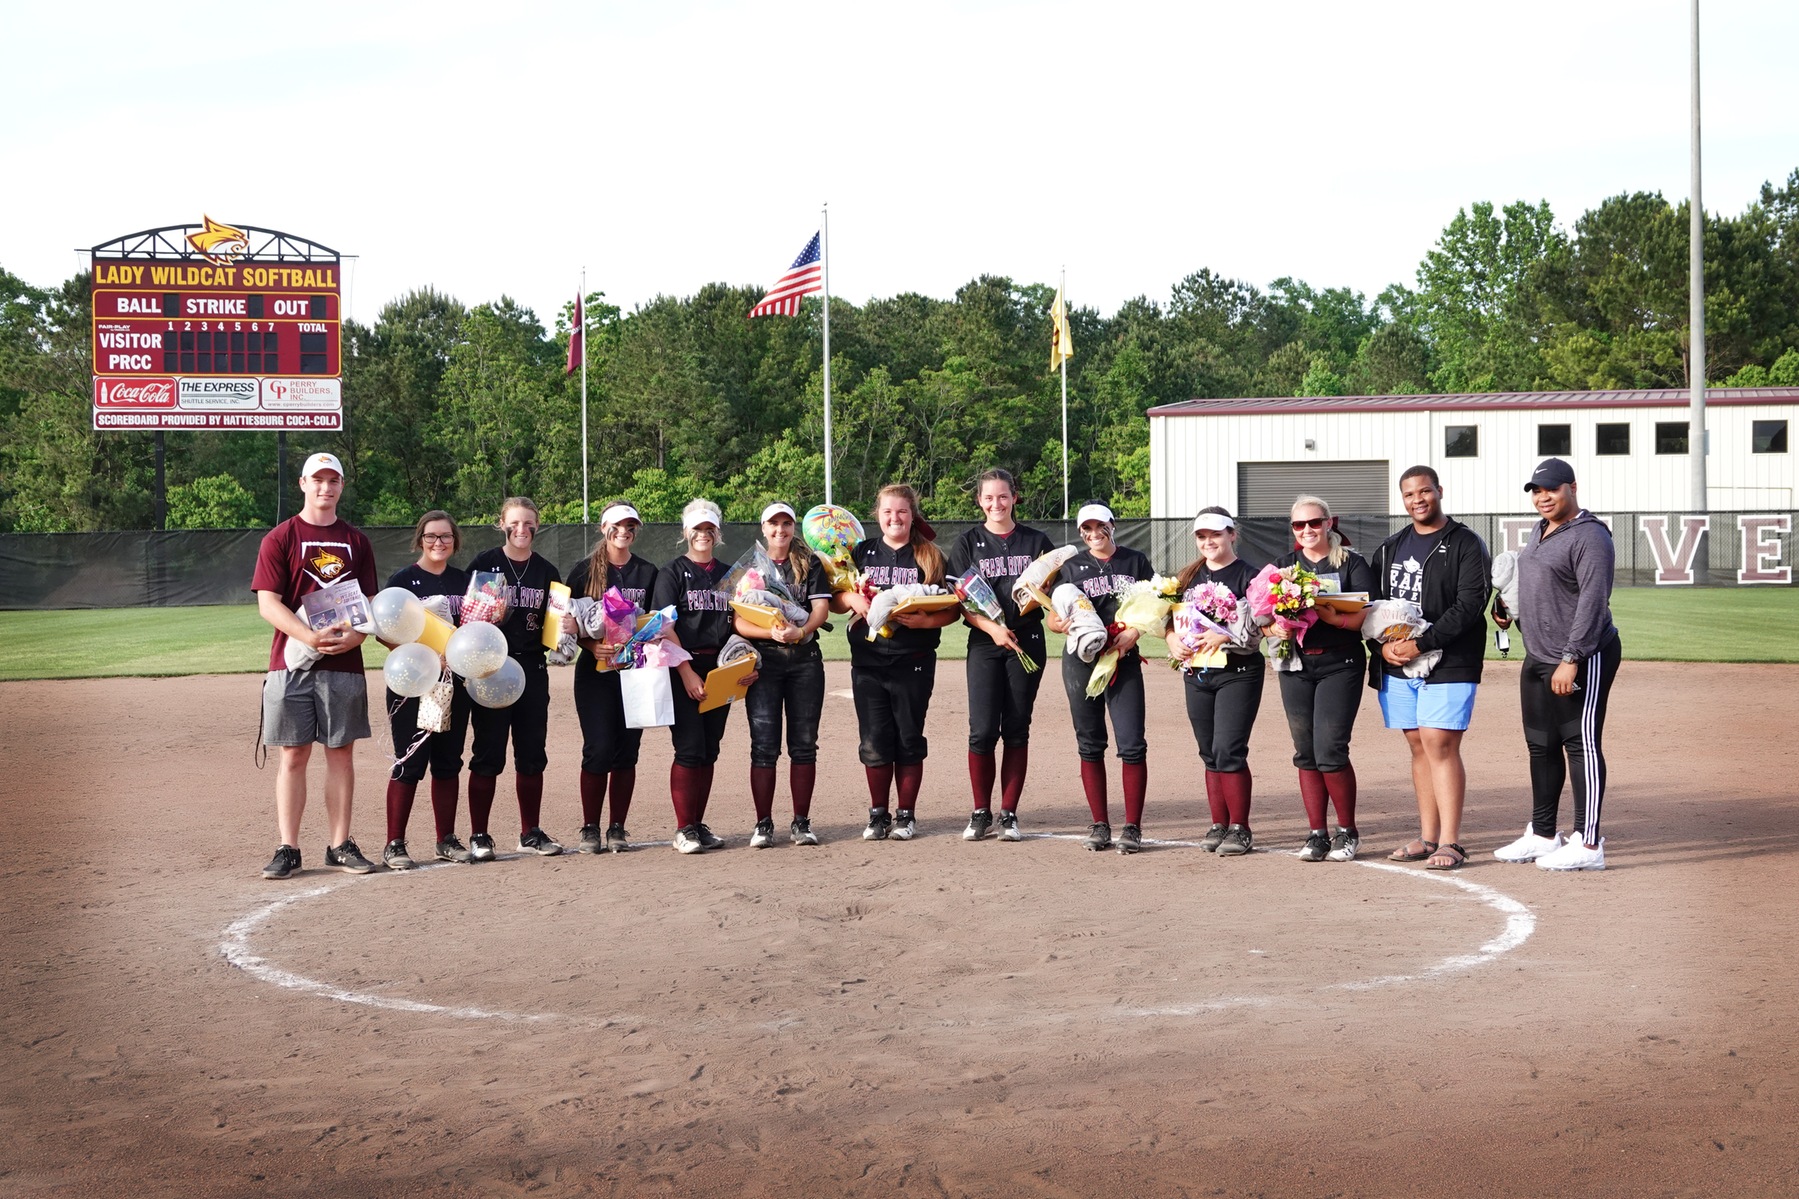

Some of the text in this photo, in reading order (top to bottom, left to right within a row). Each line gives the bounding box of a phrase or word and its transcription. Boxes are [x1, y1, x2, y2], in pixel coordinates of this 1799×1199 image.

[96, 265, 337, 287] LADY WILDCAT SOFTBALL
[117, 297, 308, 315] BALL STRIKE OUT
[168, 321, 328, 333] 1 2 3 4 5 6 7 TOTAL
[99, 333, 162, 348] VISITOR
[109, 354, 152, 370] PRCC
[110, 383, 173, 403] Coca-Cola
[181, 382, 254, 392] THE EXPRESS
[98, 415, 337, 426] SCOREBOARD PROVIDED BY HATTIESBURG COCA-COLA
[865, 566, 918, 585] PEARL RIVER
[979, 556, 1008, 579] PEARL
[1007, 555, 1033, 576] RIVE
[1083, 575, 1112, 598] PEARL
[520, 586, 545, 609] RIVER
[687, 590, 714, 611] PEARL
